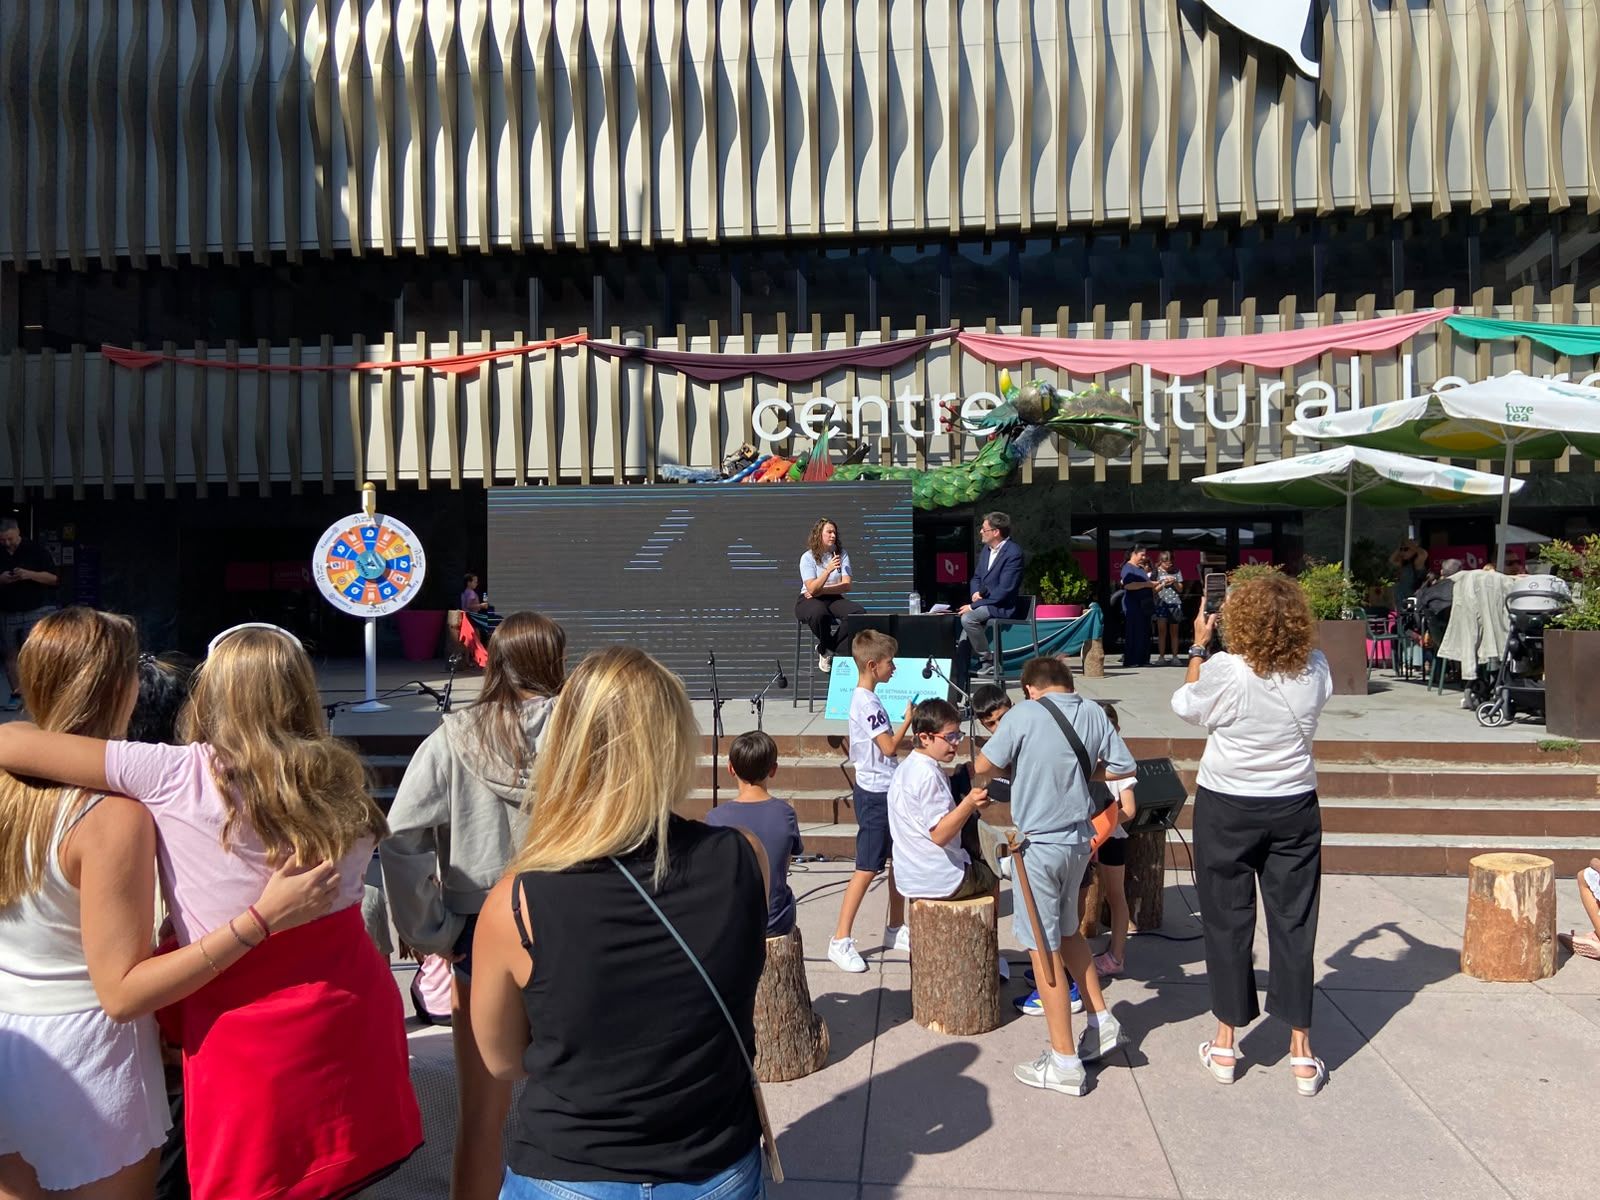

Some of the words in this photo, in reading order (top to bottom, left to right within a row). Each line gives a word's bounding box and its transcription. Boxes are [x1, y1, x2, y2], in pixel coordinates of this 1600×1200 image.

[751, 384, 1006, 442] centre
[1055, 355, 1360, 431] ltural
[1504, 402, 1534, 415] fuze
[1506, 412, 1529, 422] tea
[867, 709, 886, 731] 26
